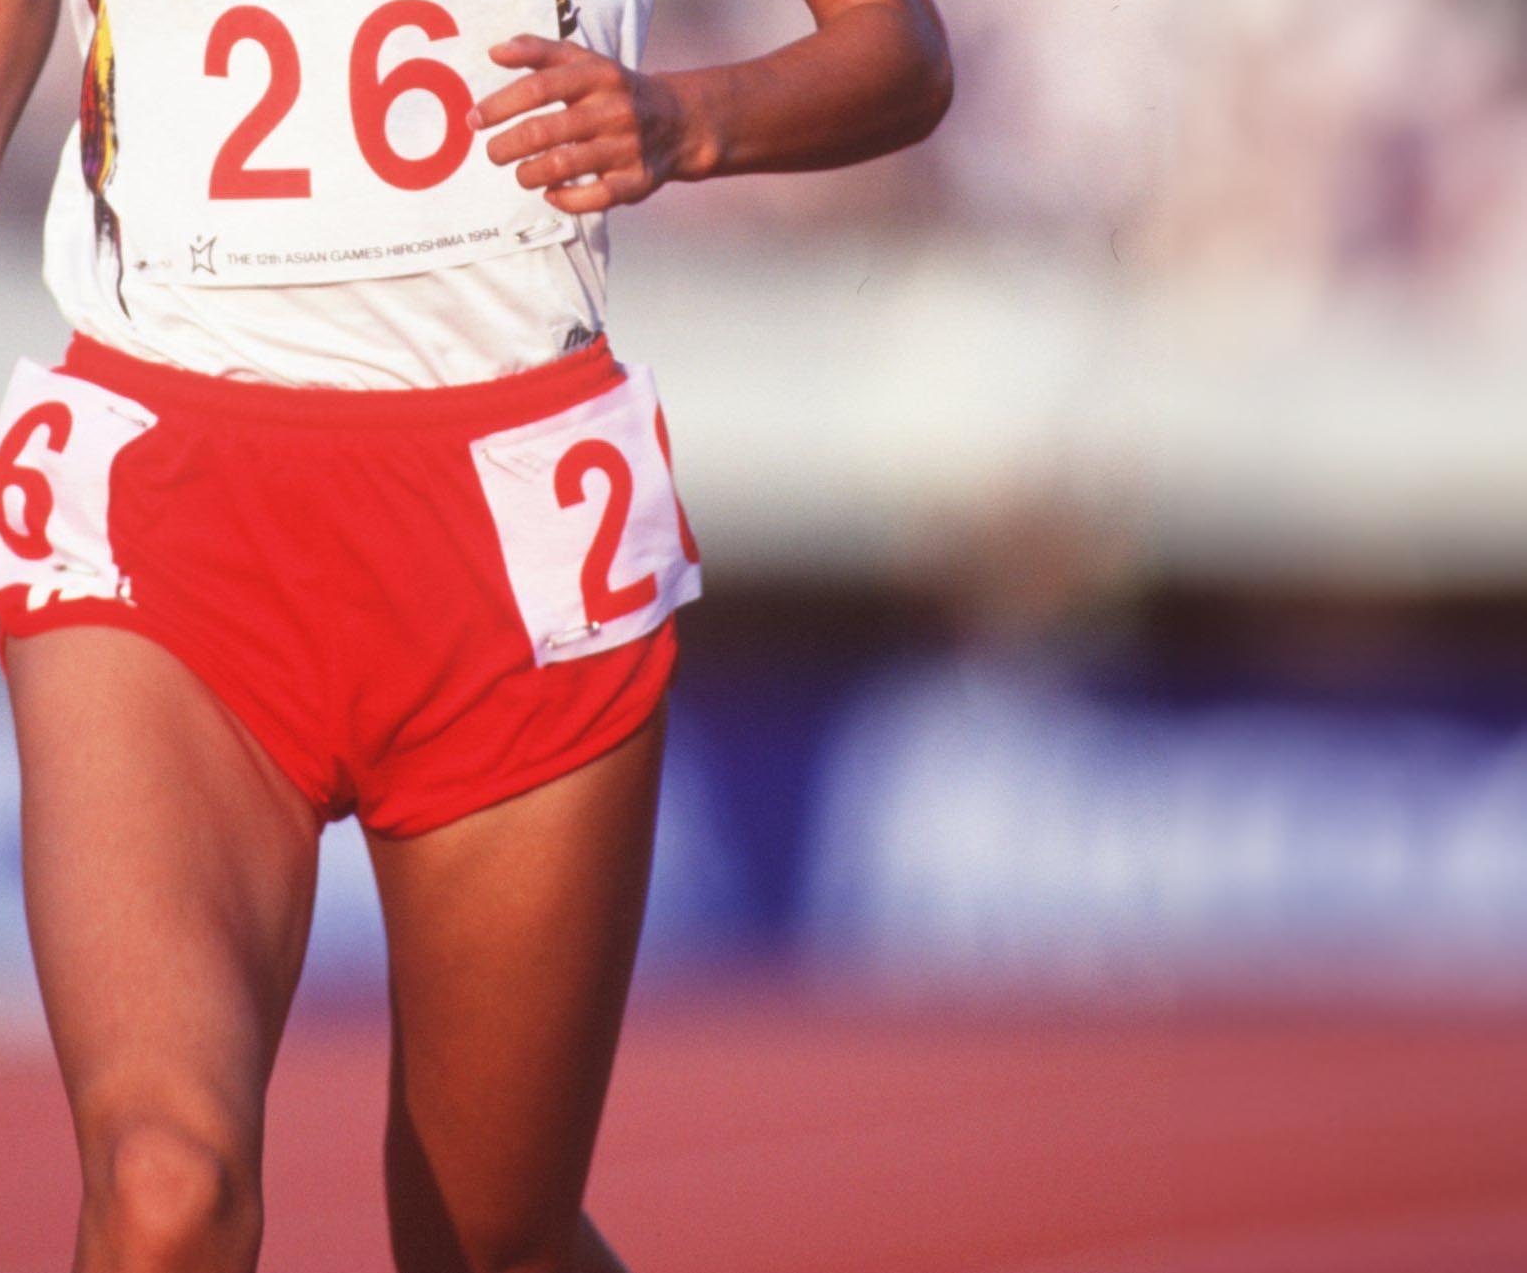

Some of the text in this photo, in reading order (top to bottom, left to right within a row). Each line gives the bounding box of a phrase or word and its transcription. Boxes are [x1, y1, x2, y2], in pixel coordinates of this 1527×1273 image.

[227, 252, 251, 265] THE
[285, 251, 327, 264] ASIAN
[331, 245, 383, 262] GAMES
[386, 234, 465, 257] HIROSHIMA
[468, 227, 500, 243] 1994
